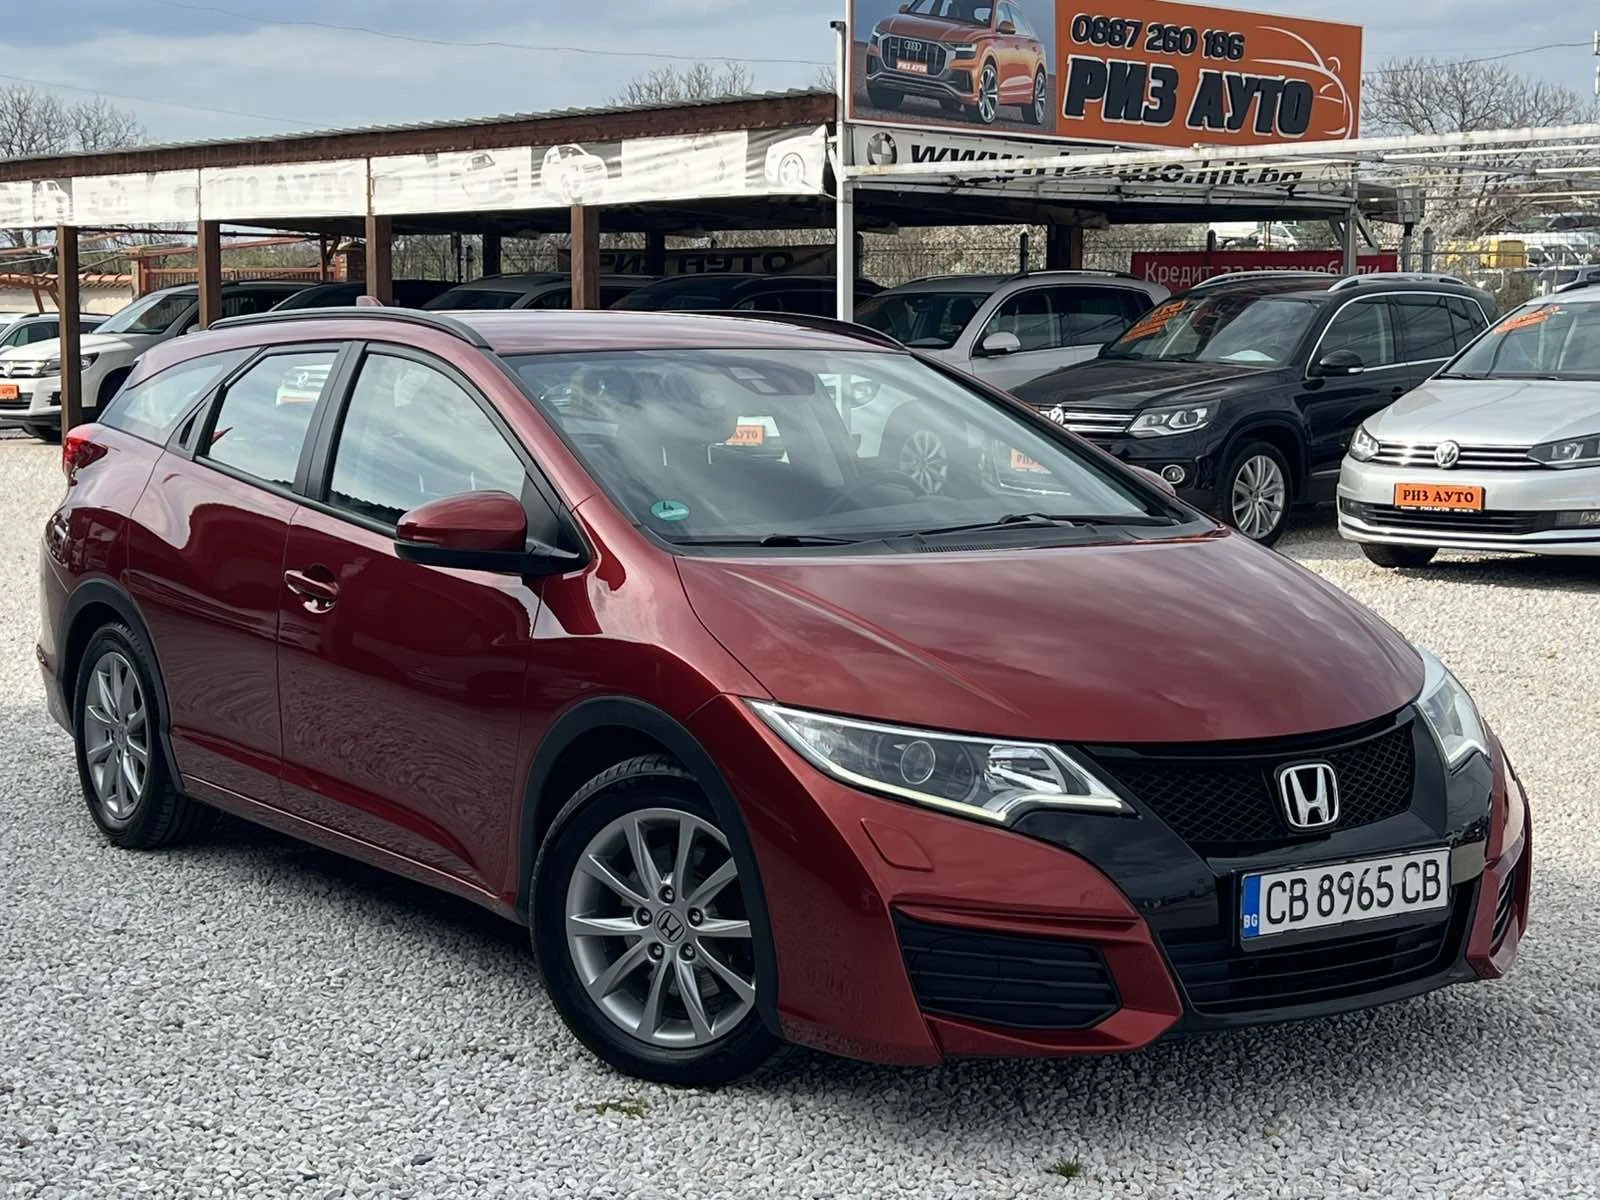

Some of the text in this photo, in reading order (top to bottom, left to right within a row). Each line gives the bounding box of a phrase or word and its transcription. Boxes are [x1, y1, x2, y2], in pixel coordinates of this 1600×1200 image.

[1071, 13, 1245, 61] 0887 260 186
[1062, 54, 1314, 138] РИЗ АУТО
[1144, 260, 1214, 286] Кредит
[1403, 490, 1474, 503] РИЗ АУТО
[1266, 858, 1442, 926] CB 8965 CB
[1243, 914, 1258, 929] BG
